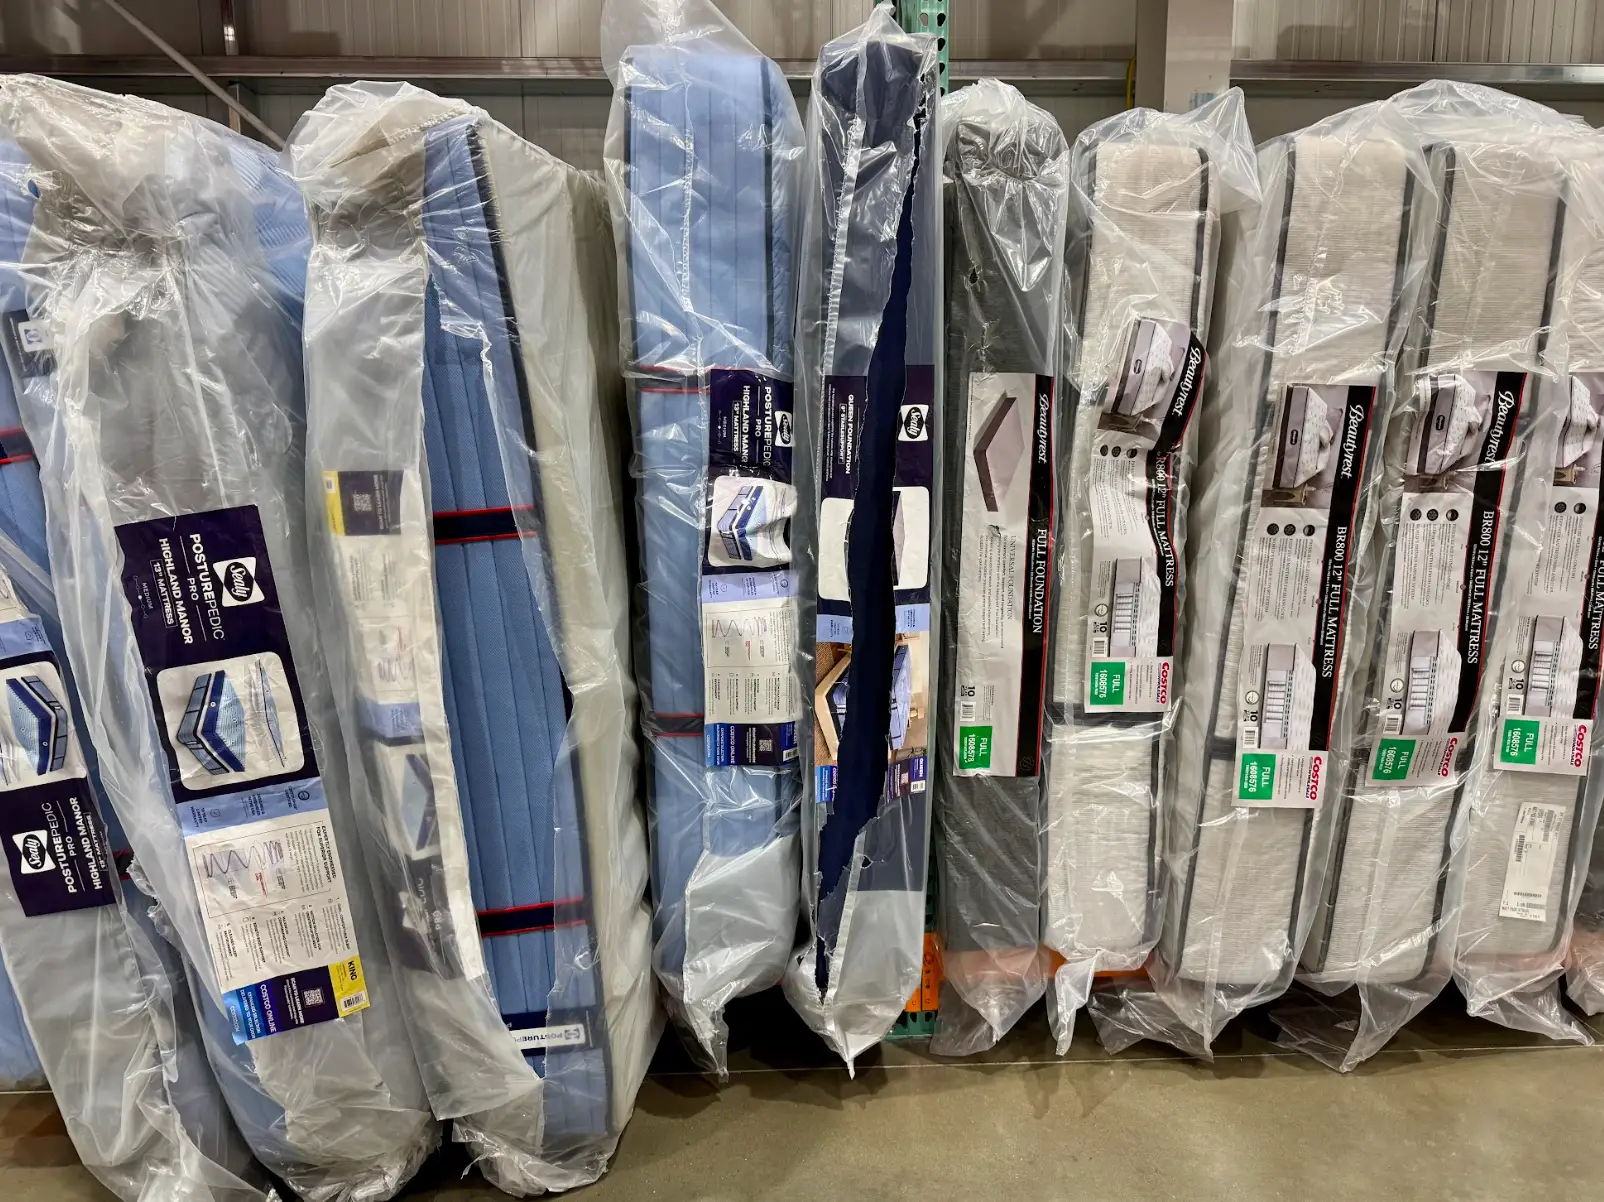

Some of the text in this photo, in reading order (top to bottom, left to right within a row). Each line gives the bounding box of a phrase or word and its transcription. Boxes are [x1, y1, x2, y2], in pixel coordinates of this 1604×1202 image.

[1172, 347, 1202, 416] Beautyrest
[742, 385, 751, 433] HIGHLAND
[907, 409, 921, 436] Sealy
[781, 416, 790, 442] Sealy
[1036, 393, 1050, 464] Beautyrest
[1340, 404, 1365, 479] Beautyrest
[1485, 390, 1515, 463] Beautyrest
[845, 423, 853, 474] FOUNDATION
[1156, 451, 1174, 587] R800 12" FULL MATTRESS
[1480, 511, 1494, 546] BR800
[1477, 549, 1489, 566] 12"
[142, 582, 153, 609] MEDIUM
[153, 562, 174, 625] 13" MATTRESS
[159, 538, 193, 644] HIGHLAND MANOR
[187, 578, 198, 600] PRO
[190, 534, 224, 640] POSTUREPEDIC
[229, 564, 252, 598] Sealy
[1033, 529, 1047, 633] FULL FOUNDATION
[1473, 569, 1486, 600] FULL
[1322, 526, 1347, 678] BR800 12" FULL MATTRESS
[1100, 622, 1107, 633] 10
[1467, 602, 1482, 664] MATTRESS
[1588, 591, 1604, 650] MATTRESS
[968, 686, 975, 697] 10
[1099, 670, 1107, 698] 1608576
[1112, 675, 1120, 693] FULL
[1160, 662, 1169, 704] COSTCO
[1516, 679, 1524, 690] 10
[1250, 710, 1258, 722] 10
[1394, 698, 1402, 709] 10
[979, 738, 988, 756] FULL
[1441, 738, 1458, 776] COSTCO
[1510, 728, 1521, 756] 1608576
[1524, 733, 1534, 752] FULL
[1574, 725, 1587, 767] COSTCO
[1248, 761, 1257, 792] 1608576
[1383, 747, 1397, 774] 1608576
[1398, 752, 1409, 769] FULL
[1262, 767, 1270, 788] FULL
[1310, 756, 1322, 800] COSTCO
[25, 838, 42, 867] Sealy
[41, 802, 77, 893] POSTUREPEDIC
[65, 836, 77, 856] PRO
[69, 797, 102, 890] HIGHLAND MANOR
[347, 961, 357, 981] KING
[260, 984, 276, 1033] COSTCO ONLINE
